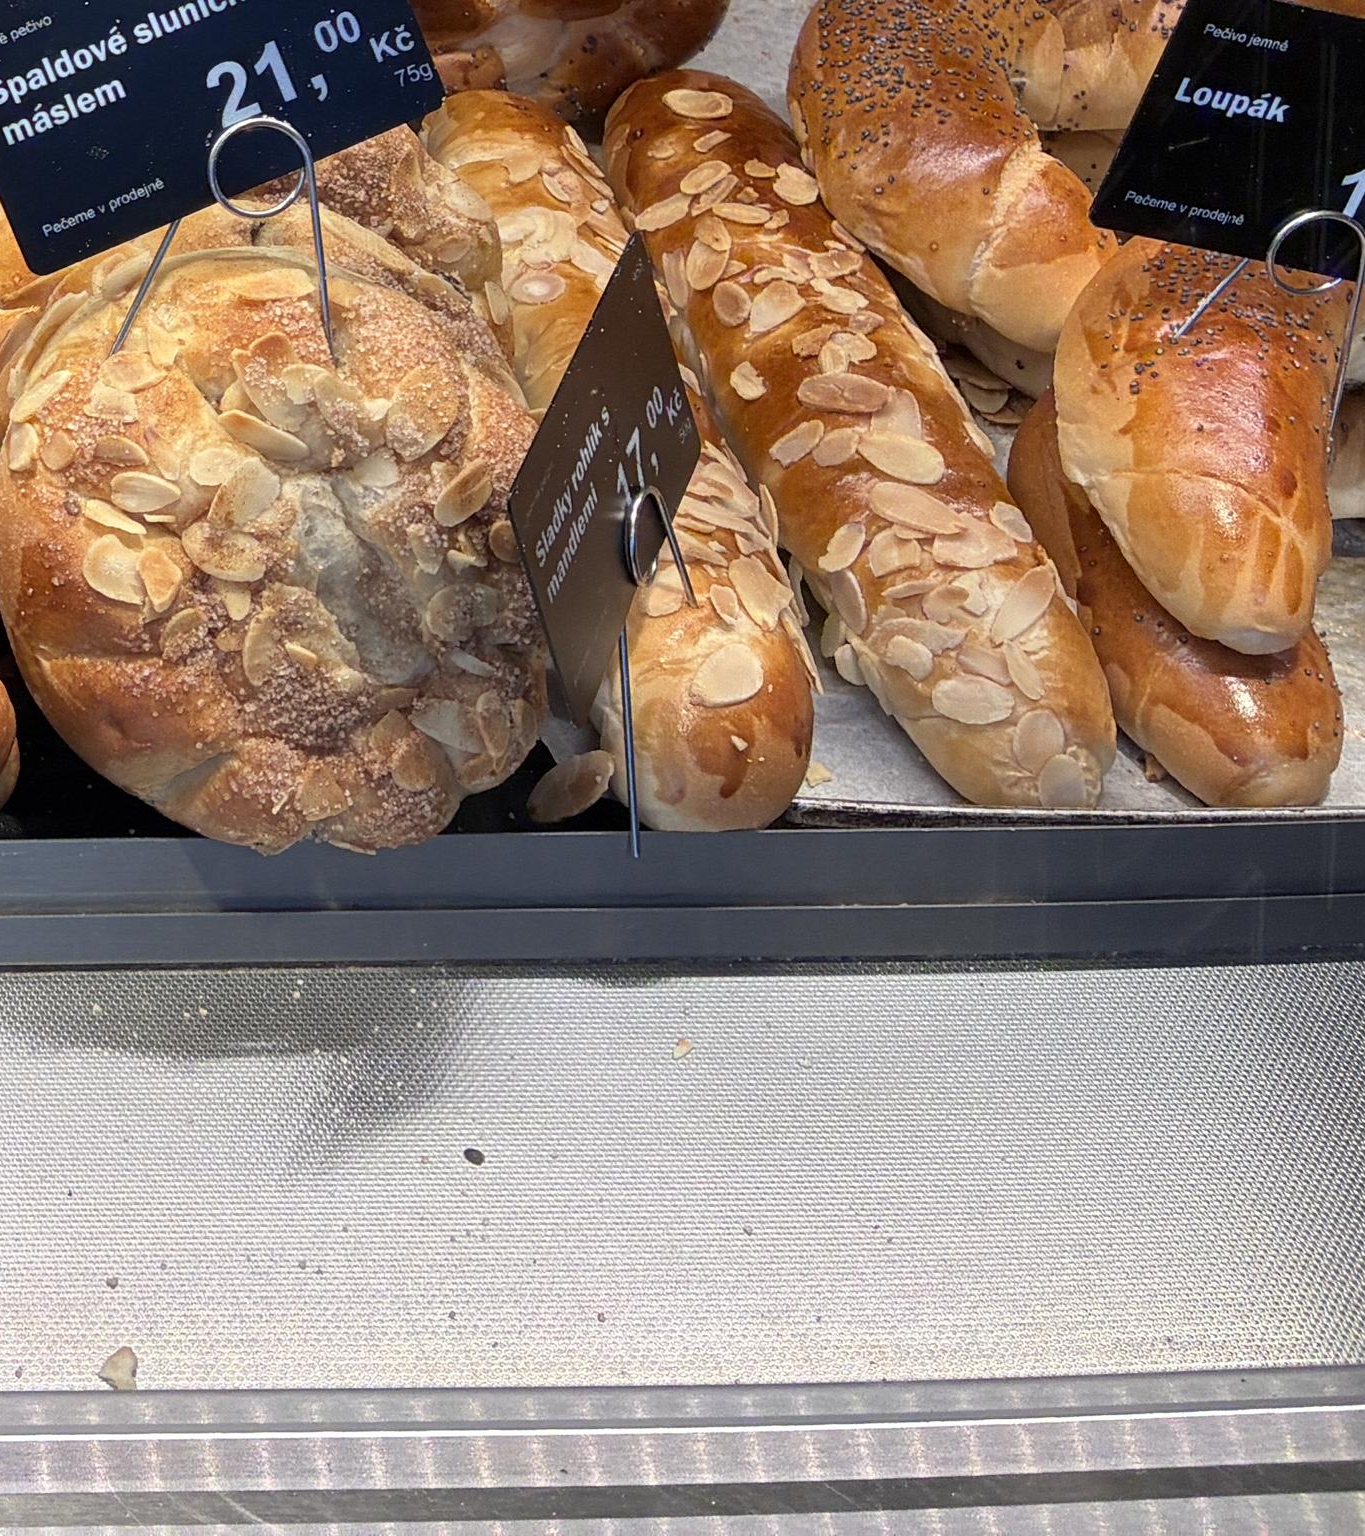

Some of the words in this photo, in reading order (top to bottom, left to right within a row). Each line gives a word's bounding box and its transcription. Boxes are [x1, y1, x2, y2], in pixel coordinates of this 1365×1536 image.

[10, 14, 53, 44] pečivo
[369, 23, 416, 64] Kč
[1204, 23, 1247, 42] Pečivo
[1248, 35, 1289, 52] jemné
[393, 62, 433, 90] 75g
[1, 76, 127, 147] máslem
[1174, 76, 1291, 122] Loupák
[41, 203, 97, 238] Pečeme
[108, 177, 165, 213] prodejně
[1125, 190, 1177, 212] Pečeme
[1188, 204, 1244, 226] prodejně
[666, 386, 683, 426] Kč
[535, 482, 573, 567] Sladký
[571, 420, 603, 491] rohlík
[601, 406, 610, 427] s
[546, 481, 598, 604] mandlemi
